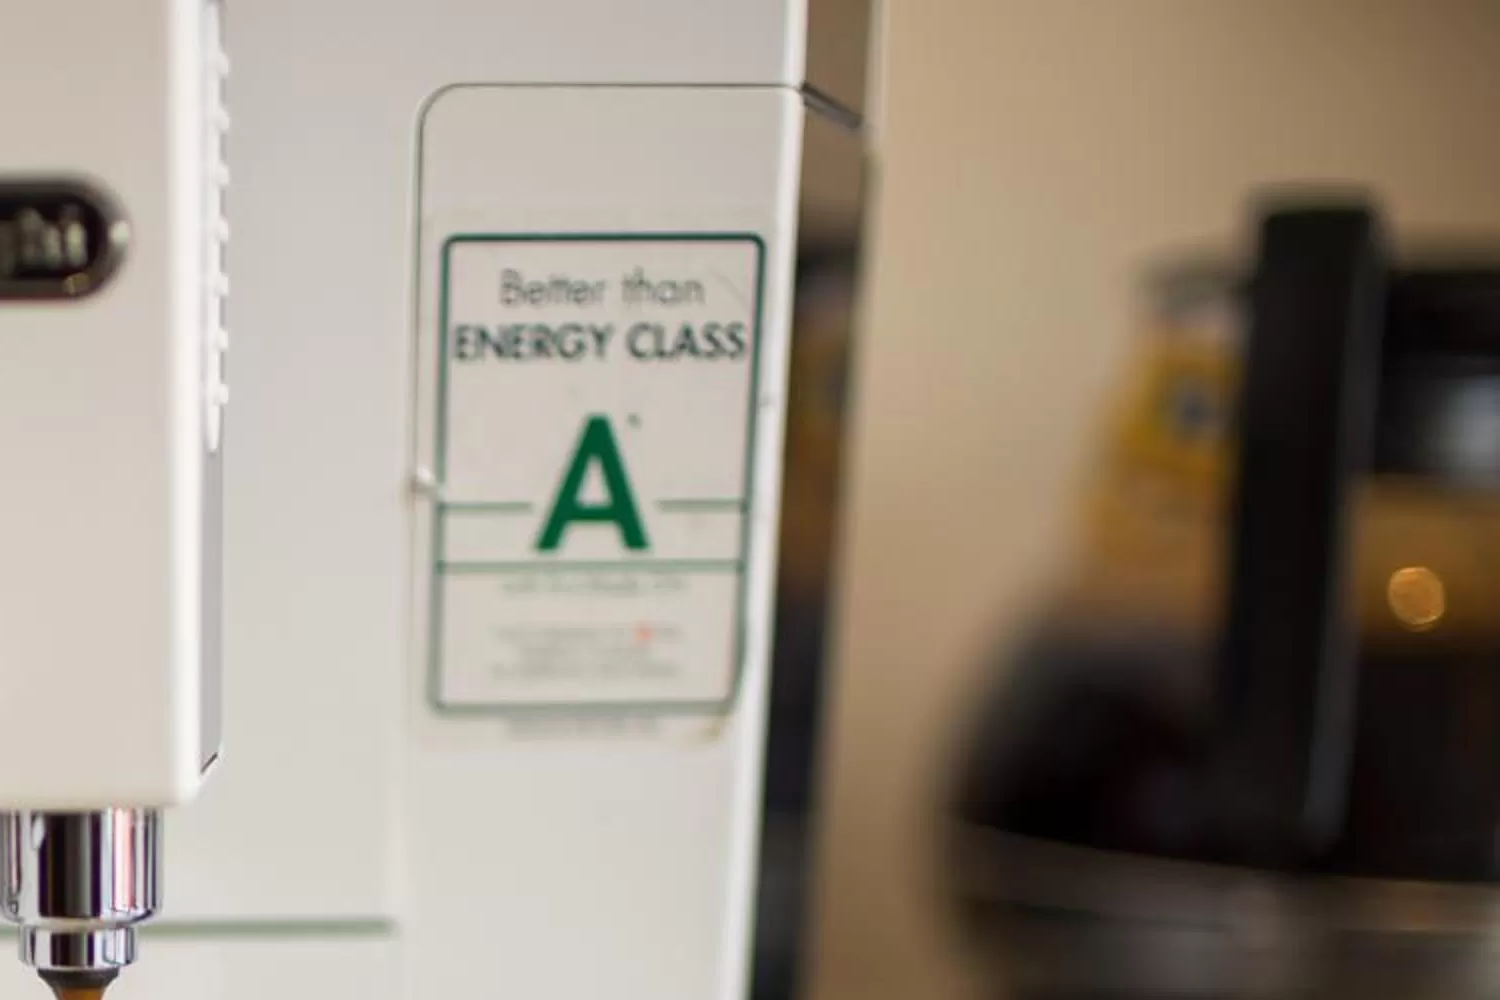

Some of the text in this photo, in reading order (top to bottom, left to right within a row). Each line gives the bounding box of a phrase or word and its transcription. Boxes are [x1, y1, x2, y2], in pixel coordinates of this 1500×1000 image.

[500, 266, 706, 305] Better than
[453, 321, 746, 361] ENERGY CLASS
[536, 413, 650, 552] A
